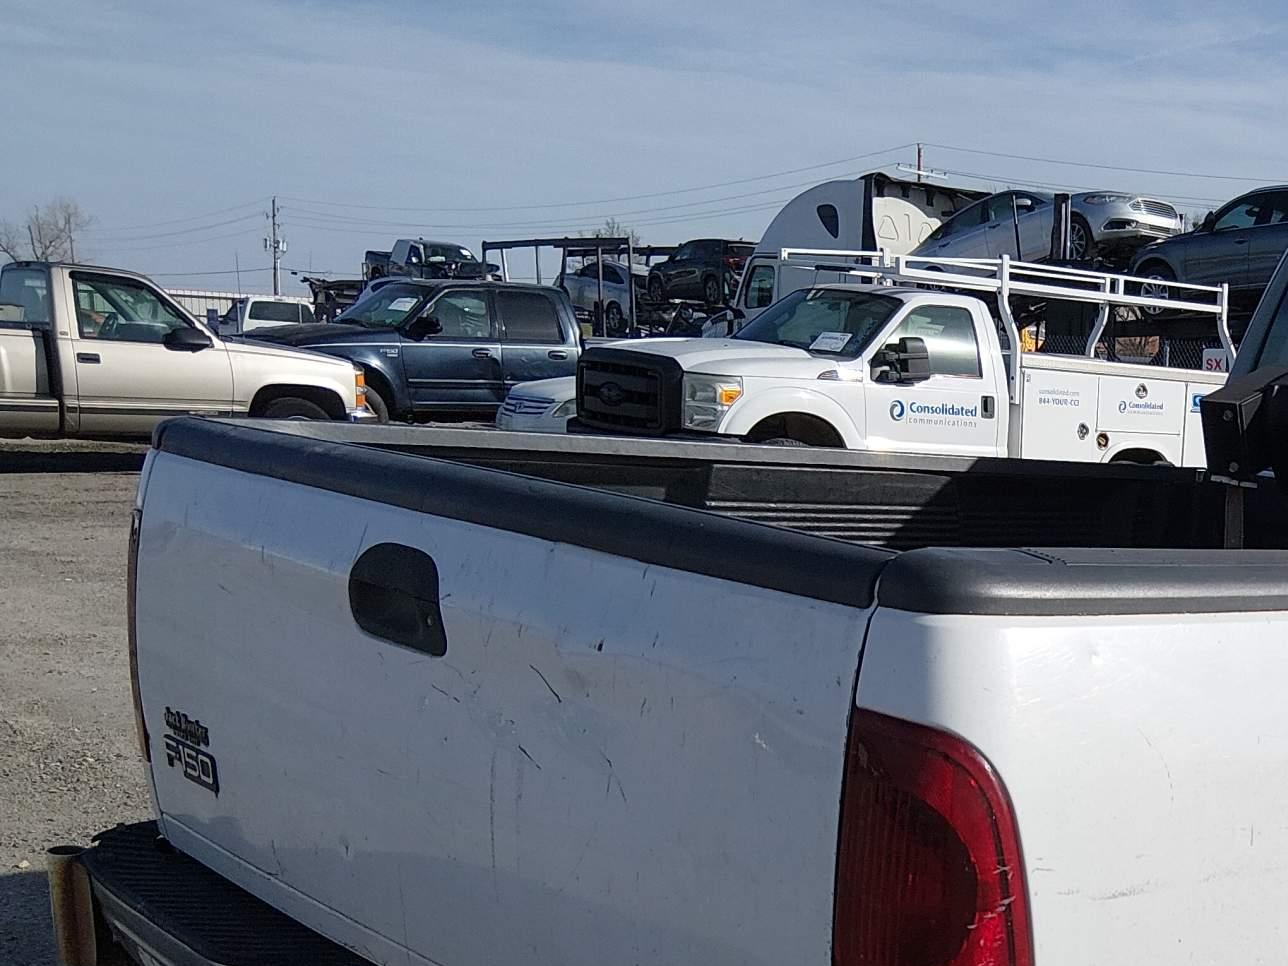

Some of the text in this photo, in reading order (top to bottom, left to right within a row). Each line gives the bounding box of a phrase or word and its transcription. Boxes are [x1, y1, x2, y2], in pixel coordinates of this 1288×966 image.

[1205, 358, 1223, 370] SX
[909, 401, 978, 417] Consolidated
[1128, 401, 1164, 410] Consolidated
[908, 416, 978, 428] communications
